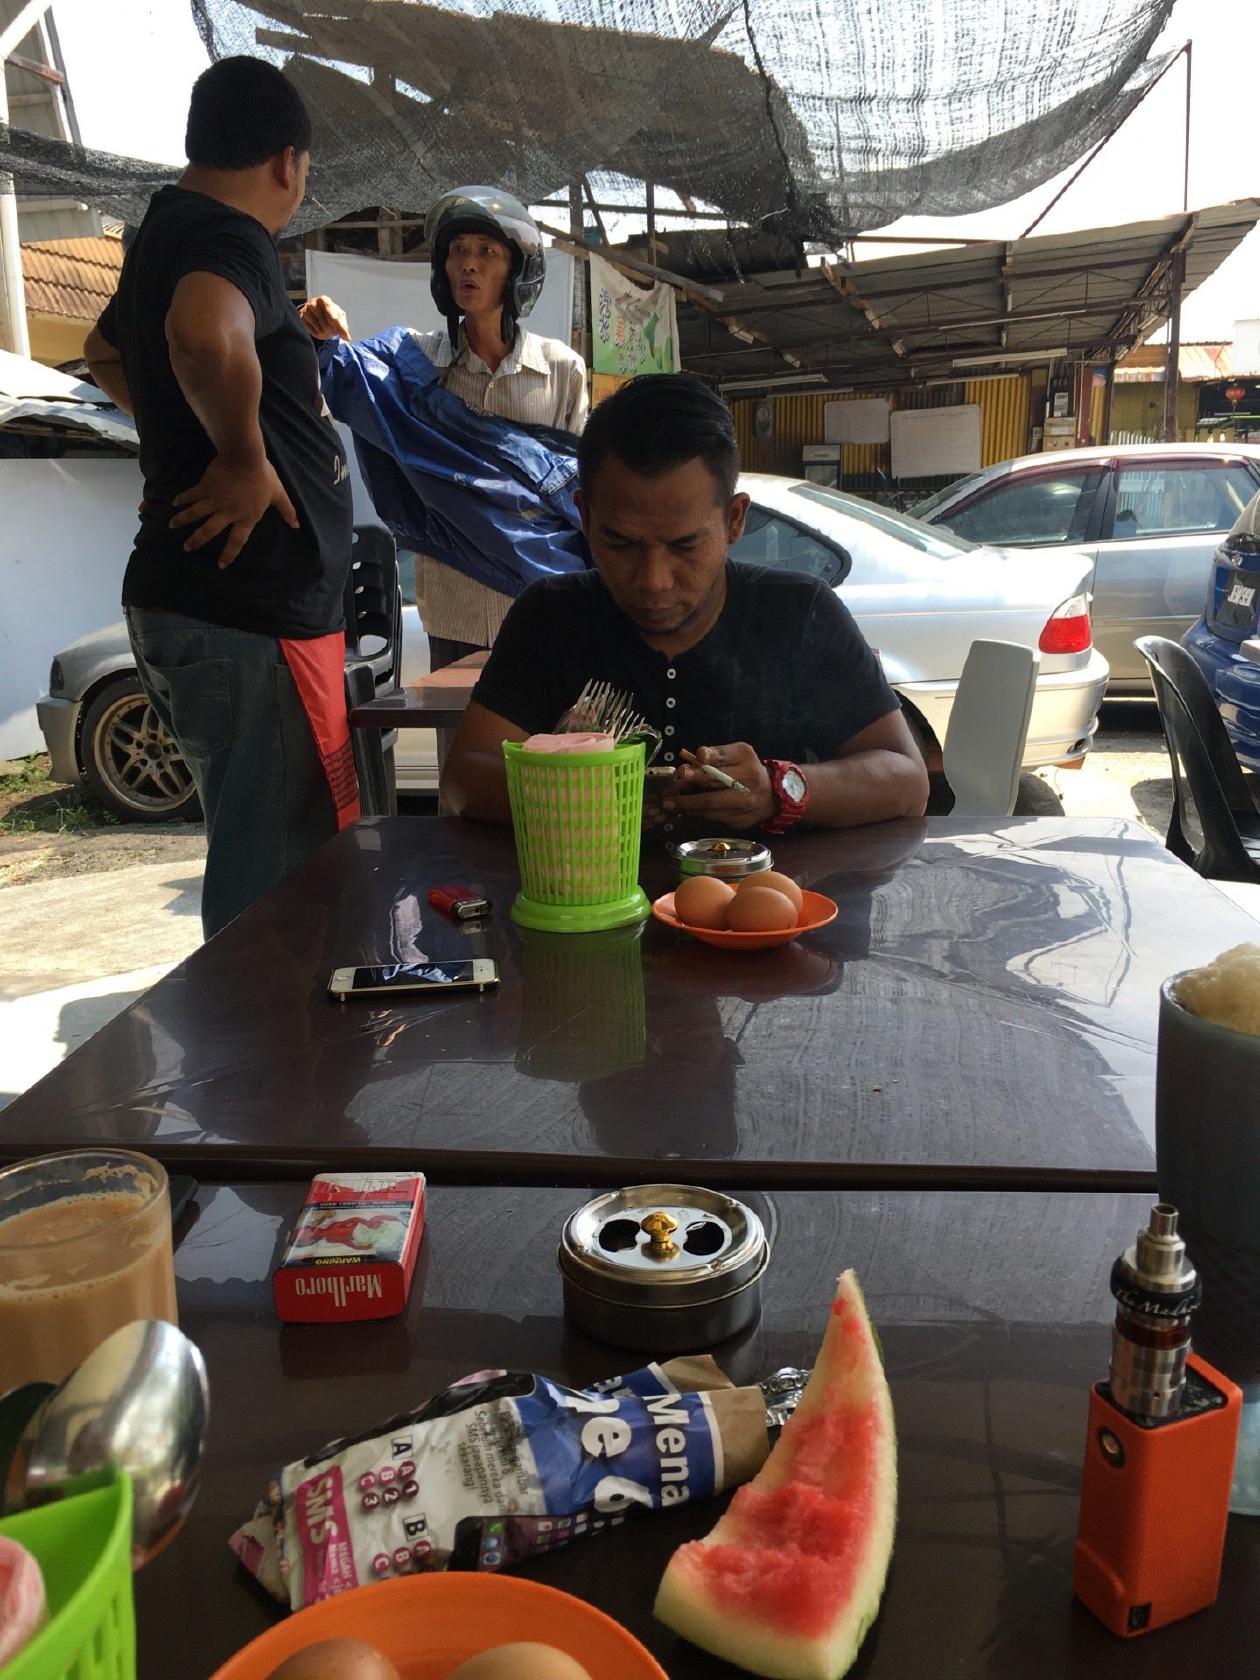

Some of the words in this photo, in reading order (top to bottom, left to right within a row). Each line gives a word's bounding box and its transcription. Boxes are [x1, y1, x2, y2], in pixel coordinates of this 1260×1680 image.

[315, 1256, 361, 1265] WARNING
[295, 1274, 383, 1307] Marlboro
[466, 1424, 479, 1443] SMS
[394, 1443, 411, 1456] A
[360, 1474, 375, 1487] C
[380, 1469, 395, 1483] B
[467, 1445, 492, 1504] jawapannya
[404, 1482, 418, 1495] 1
[364, 1495, 379, 1508] 3
[383, 1490, 398, 1503] 2
[304, 1477, 338, 1544] SMS
[405, 1519, 424, 1536] B
[374, 1556, 390, 1570] C
[395, 1549, 410, 1564] B
